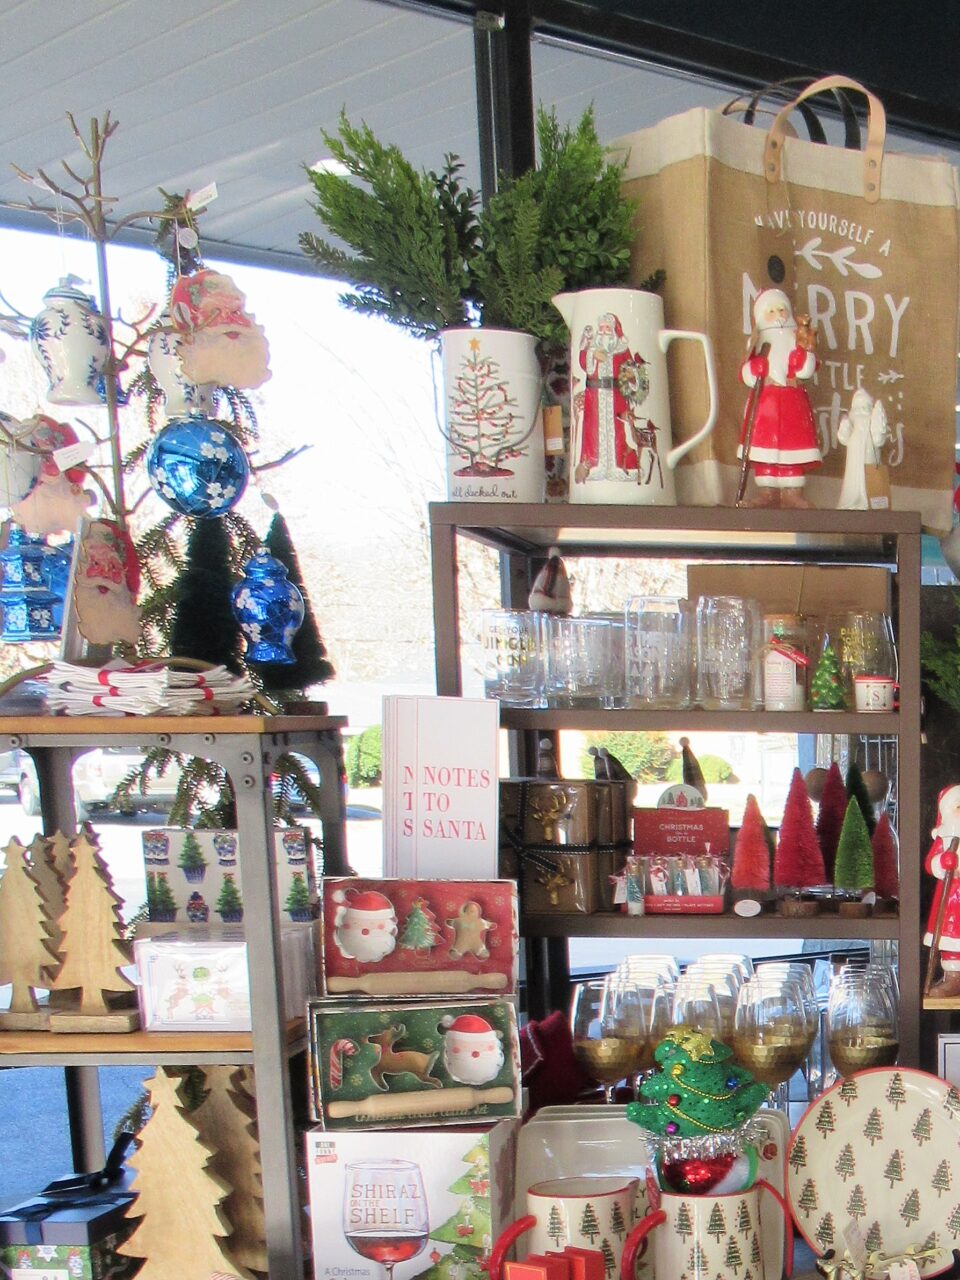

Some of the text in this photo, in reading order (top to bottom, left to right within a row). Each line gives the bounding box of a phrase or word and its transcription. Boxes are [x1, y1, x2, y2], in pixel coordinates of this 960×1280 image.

[799, 210, 874, 245] YOURSELF
[879, 239, 892, 257] A
[742, 272, 910, 358] MRRY
[423, 766, 491, 788] NOTES
[423, 792, 450, 812] TO
[423, 819, 487, 841] SANTA
[659, 823, 704, 832] CHRISTMAS
[351, 1184, 421, 1199] SHIRAZ
[350, 1200, 381, 1208] ON THE
[350, 1208, 415, 1224] SHELF
[324, 1267, 370, 1277] A Christmas
